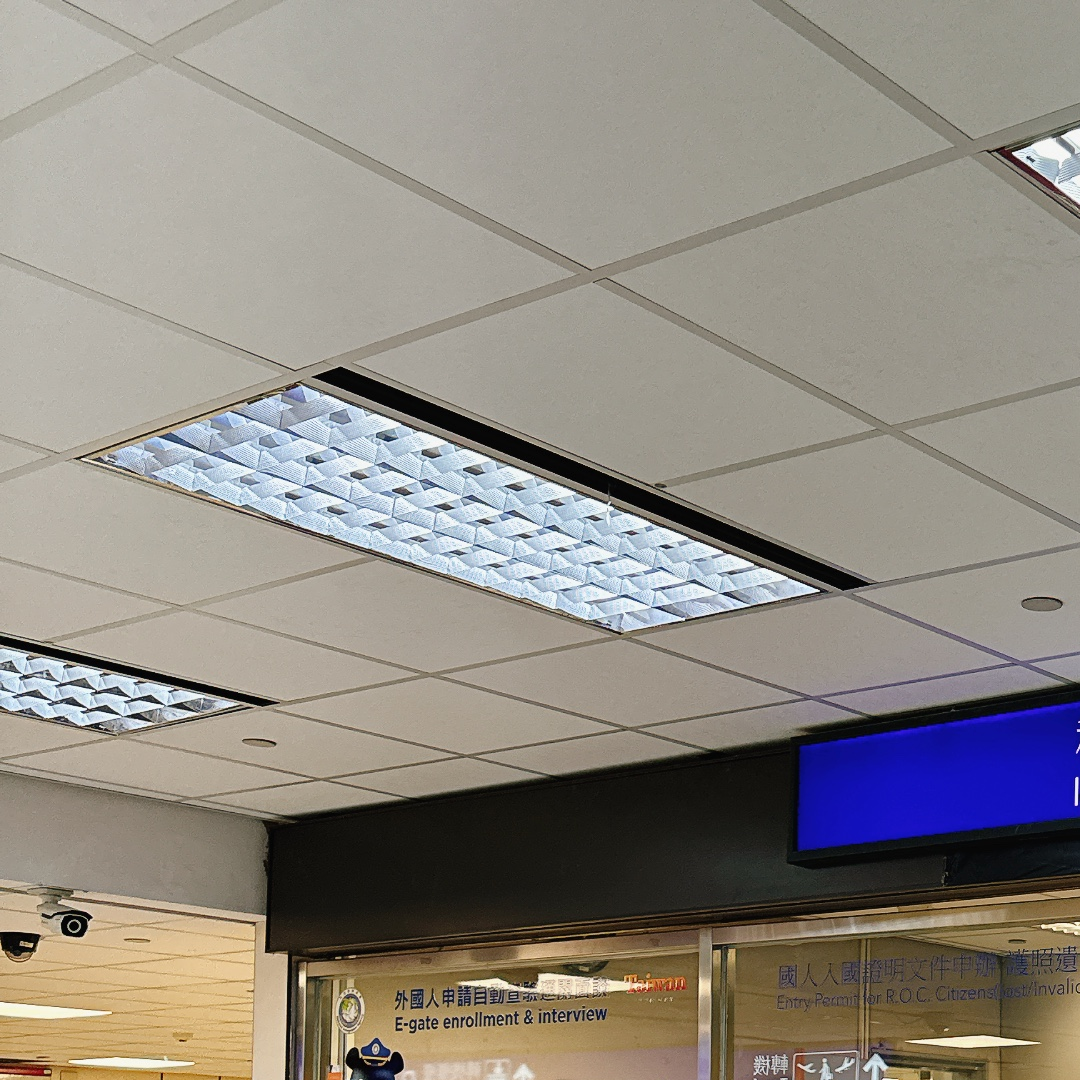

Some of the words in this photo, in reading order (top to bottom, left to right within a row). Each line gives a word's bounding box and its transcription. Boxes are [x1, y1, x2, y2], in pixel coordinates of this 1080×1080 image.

[624, 972, 687, 994] Taiwan
[777, 993, 810, 1013] Entry
[815, 991, 860, 1009] Permit
[887, 986, 931, 1004] R.O.C.
[395, 1016, 439, 1034] E-gate
[443, 1010, 519, 1029] enrollment
[524, 1009, 533, 1025] &
[538, 1005, 608, 1024] interview
